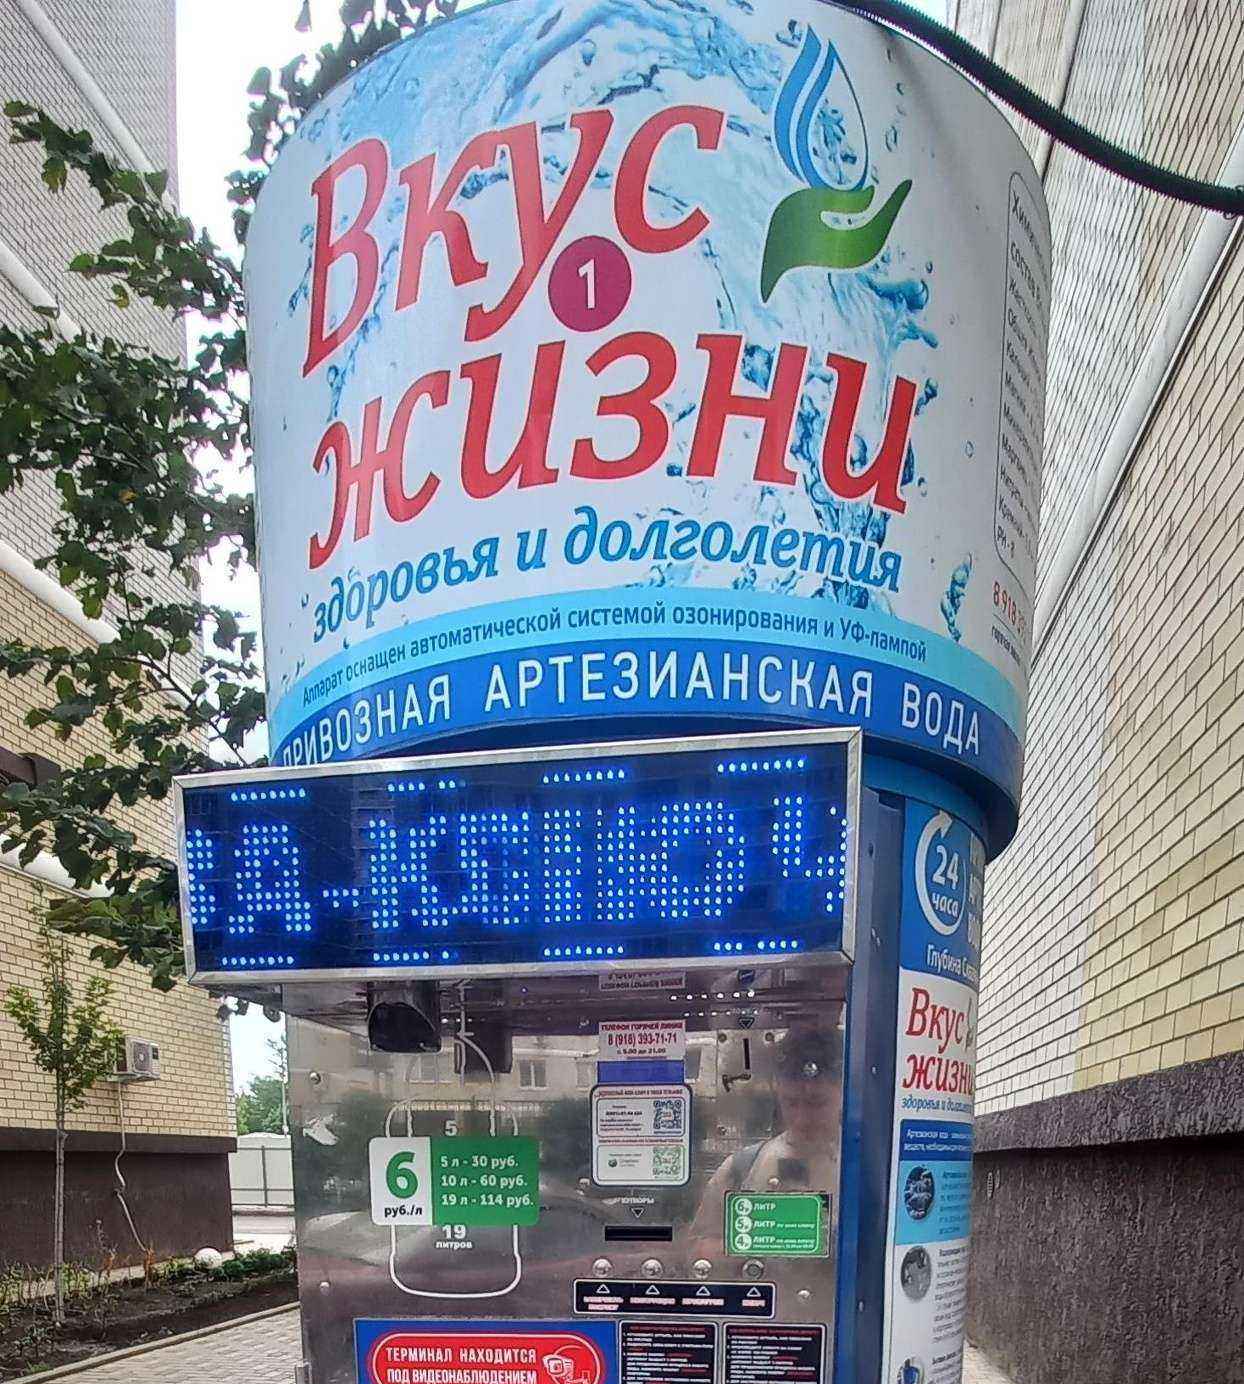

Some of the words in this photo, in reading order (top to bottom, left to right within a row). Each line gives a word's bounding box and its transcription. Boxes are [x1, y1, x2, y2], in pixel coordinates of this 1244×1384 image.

[303, 105, 729, 377] Вкус
[577, 265, 599, 309] 1
[309, 332, 917, 570] жизни
[313, 534, 500, 643] здоровья
[514, 523, 549, 573] и
[562, 505, 903, 594] долголетия
[303, 668, 344, 708] Аппарат
[345, 646, 407, 682] оснащен
[410, 605, 561, 657] автоматической
[567, 601, 666, 629] системой
[672, 605, 818, 637] озонирования
[824, 620, 834, 639] и
[839, 616, 927, 663] УФ-лампой
[283, 673, 451, 768] ПРИВОЗНАЯ
[484, 650, 873, 719] АРТЕЗИАНСКАЯ
[901, 681, 980, 756] ВОДА
[932, 844, 959, 891] 24
[930, 891, 959, 918] часа
[906, 986, 965, 1054] Вкус
[385, 1150, 419, 1200] 6
[441, 1156, 448, 1168] 5
[451, 1158, 460, 1168] л
[471, 1155, 489, 1168] 30
[491, 1155, 520, 1170] руб.
[441, 1174, 457, 1187] 10
[459, 1177, 468, 1187] л
[480, 1174, 497, 1187] 60
[500, 1174, 528, 1190] руб.
[384, 1205, 423, 1218] руб./л
[441, 1194, 457, 1206] 19
[459, 1196, 469, 1206] л
[480, 1193, 504, 1205] 114
[506, 1193, 534, 1208] руб.
[441, 1223, 467, 1240] 19
[386, 1346, 453, 1363] ТЕРМИНАЛ
[459, 1347, 537, 1365] НАХОДИТСЯ
